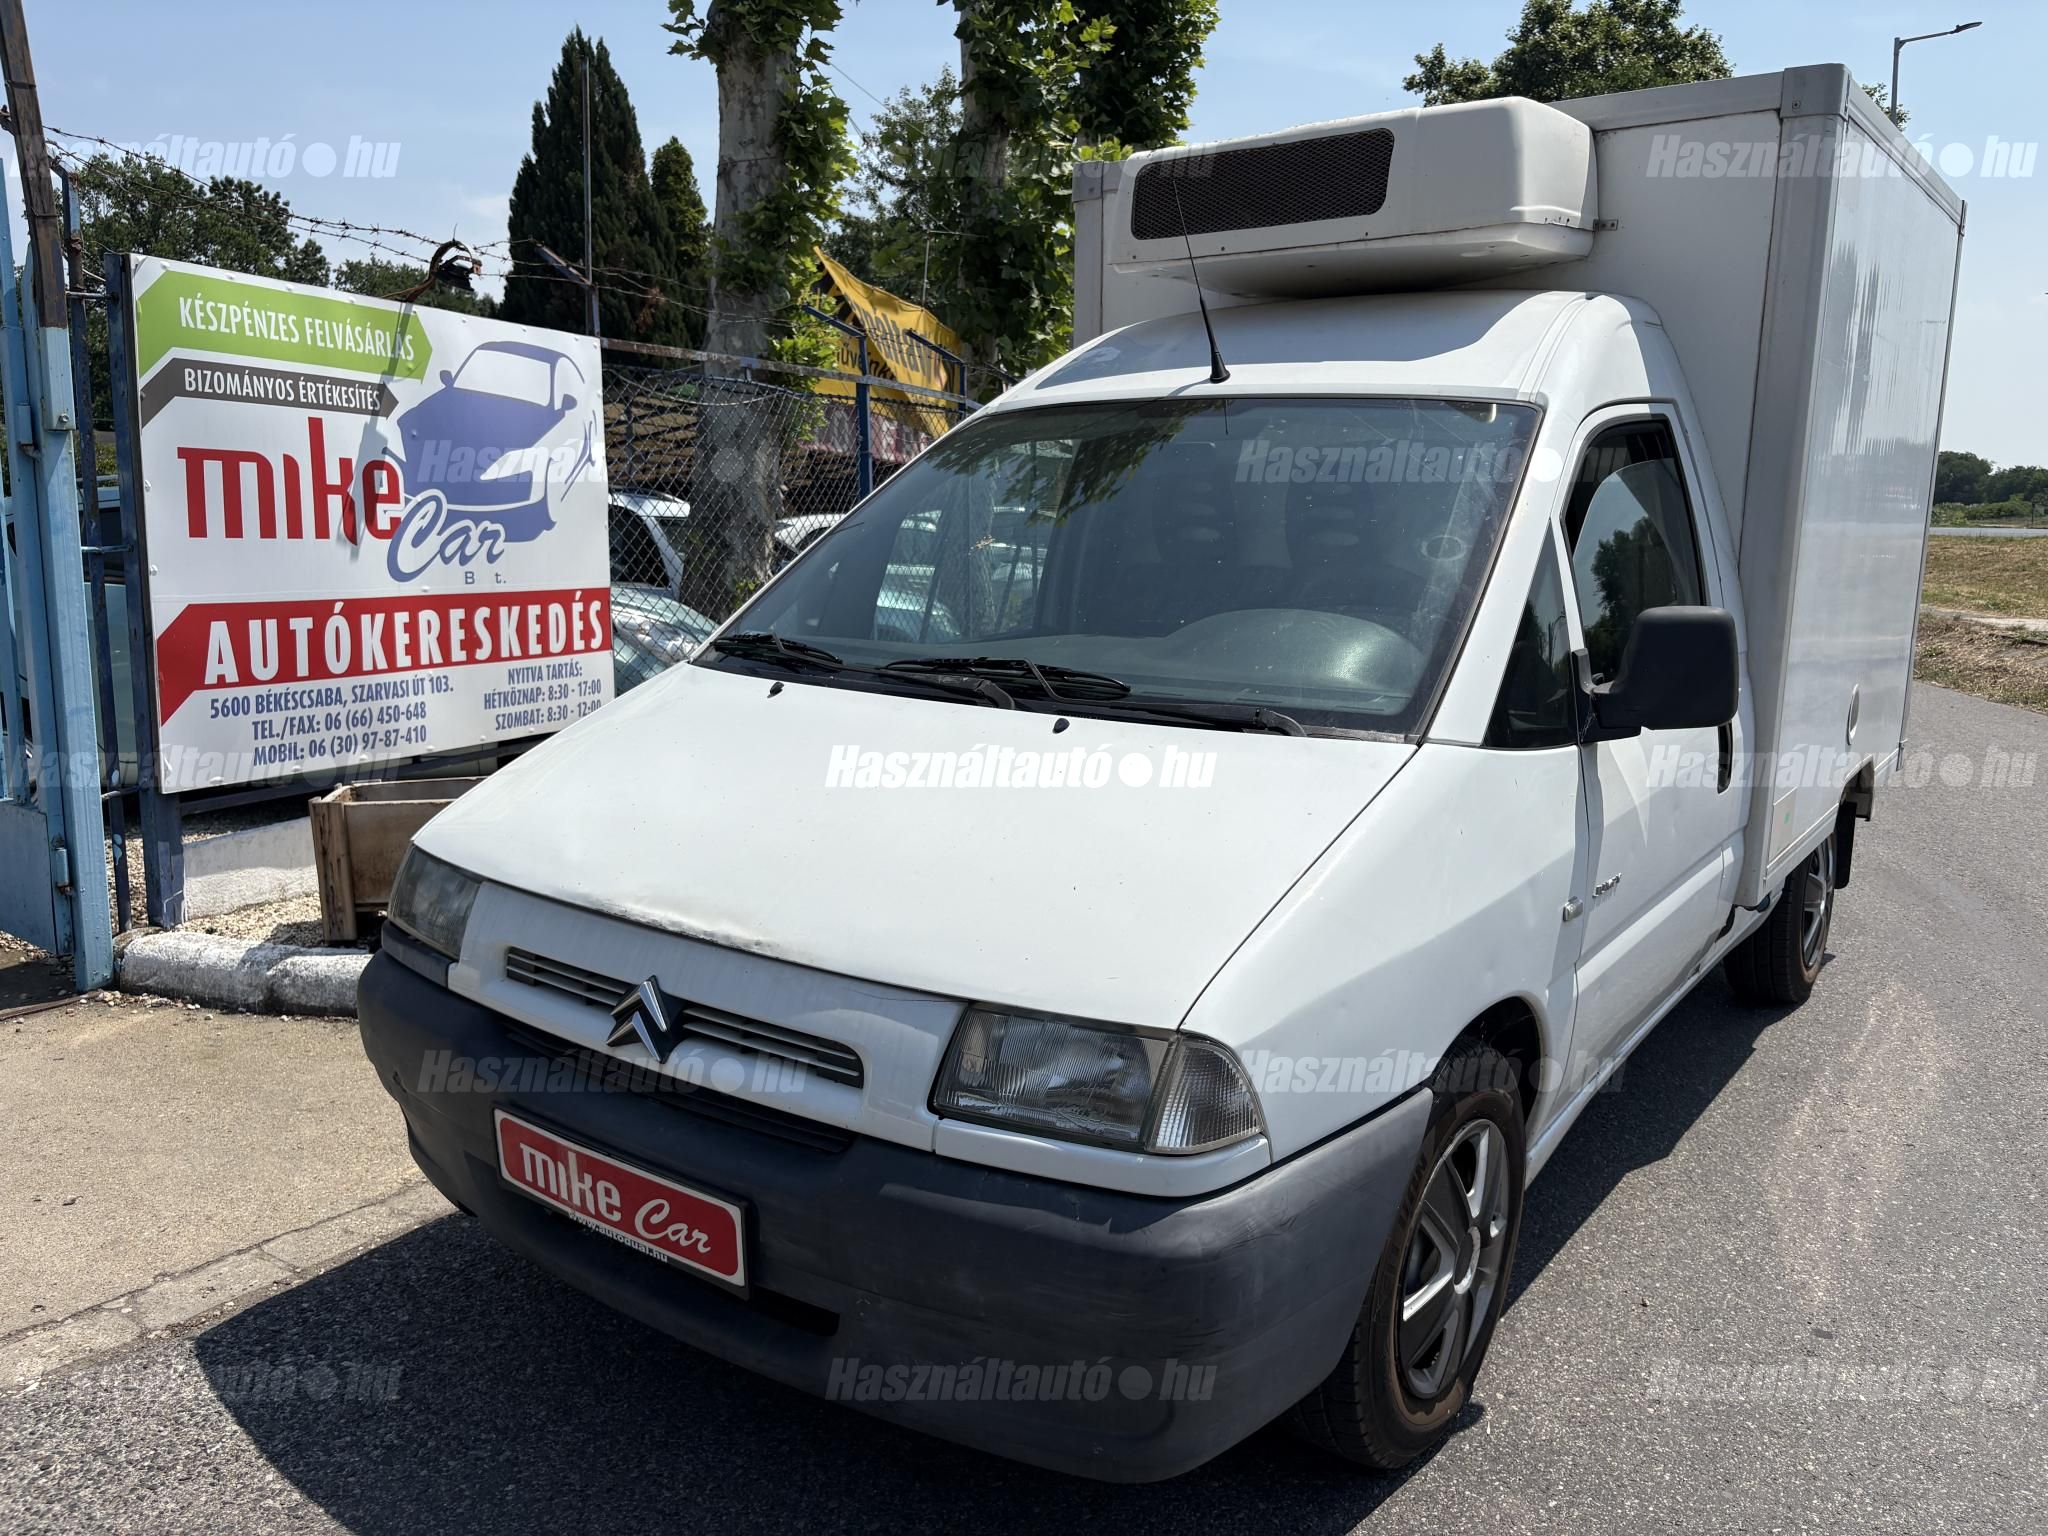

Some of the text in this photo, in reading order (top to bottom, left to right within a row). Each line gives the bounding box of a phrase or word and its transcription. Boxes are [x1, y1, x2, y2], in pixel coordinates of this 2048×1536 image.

[179, 293, 414, 361] KÉSZPÉNZES FELVÁSÁRLÁS
[185, 367, 380, 410] BIZOMÁNYOS ÉRTÉKESÍTÉS
[177, 416, 403, 545] mike
[387, 494, 504, 582] Car
[204, 591, 602, 685] AUTÓKERESKEDÉS
[508, 659, 582, 685] NYITVA TARTÁS:
[211, 675, 454, 719] 5600 BÉKÉSCSABA, SZARVASI ÚT 103.
[484, 687, 545, 709] HÉTKÖZNAP:
[548, 684, 568, 700] 8:30
[578, 679, 601, 696] 17:00
[496, 709, 544, 730] SZOMBAT:
[548, 705, 568, 722] 8:30
[577, 700, 601, 717] 12:00
[252, 701, 426, 740] TEL./FAX: 06 (66) 450-648
[253, 725, 426, 766] MOBIL: 06 (30) 97-87-410
[520, 1142, 711, 1254] mike Car
